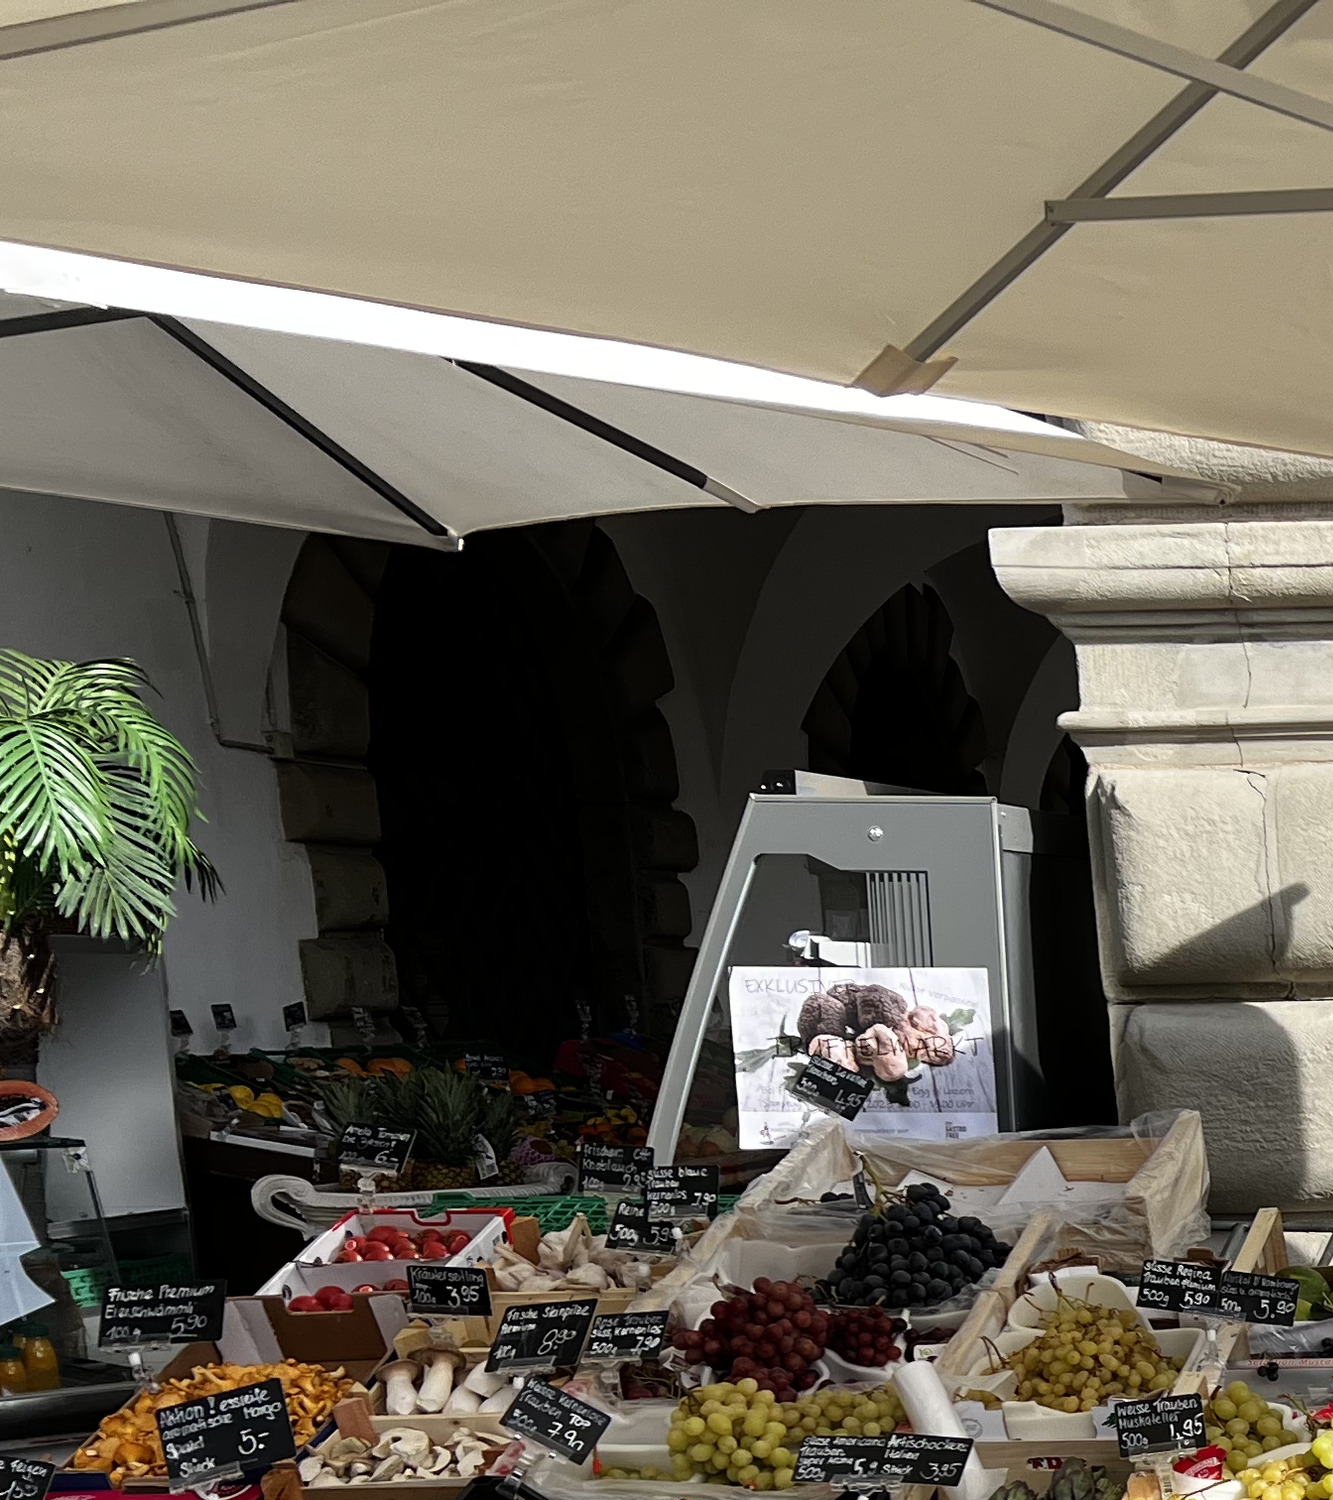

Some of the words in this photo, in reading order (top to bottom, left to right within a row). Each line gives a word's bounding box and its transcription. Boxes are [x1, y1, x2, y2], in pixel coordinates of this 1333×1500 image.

[1176, 1264, 1213, 1281] Regina
[1139, 1288, 1170, 1307] 500g
[1253, 1299, 1297, 1320] 5.90
[537, 1328, 577, 1355] 8.90
[590, 1342, 617, 1357] 500g
[1152, 1398, 1199, 1414] Trauben
[1121, 1433, 1149, 1450] 500g
[795, 1465, 826, 1482] 500g
